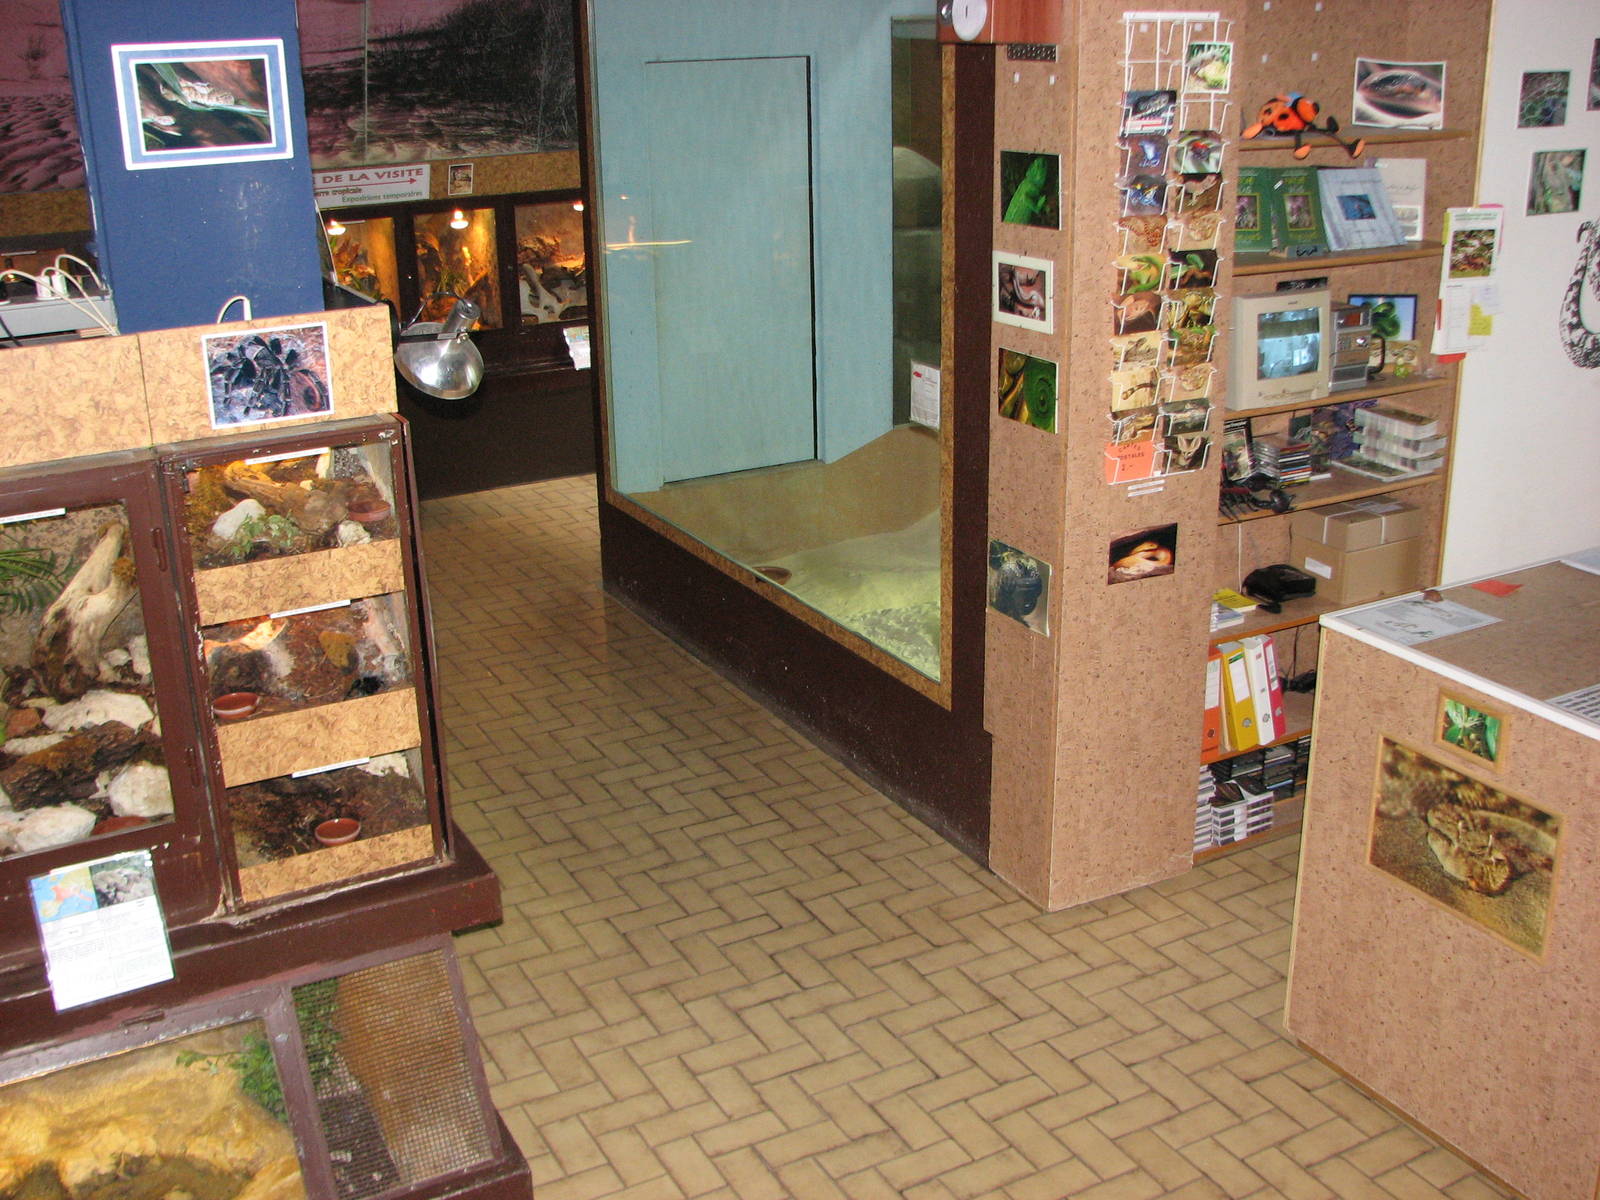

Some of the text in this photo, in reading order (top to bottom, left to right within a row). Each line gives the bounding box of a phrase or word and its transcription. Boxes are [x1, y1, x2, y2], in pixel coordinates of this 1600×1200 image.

[322, 174, 343, 184] DE
[349, 173, 370, 182] LA
[374, 168, 424, 180] VISITE
